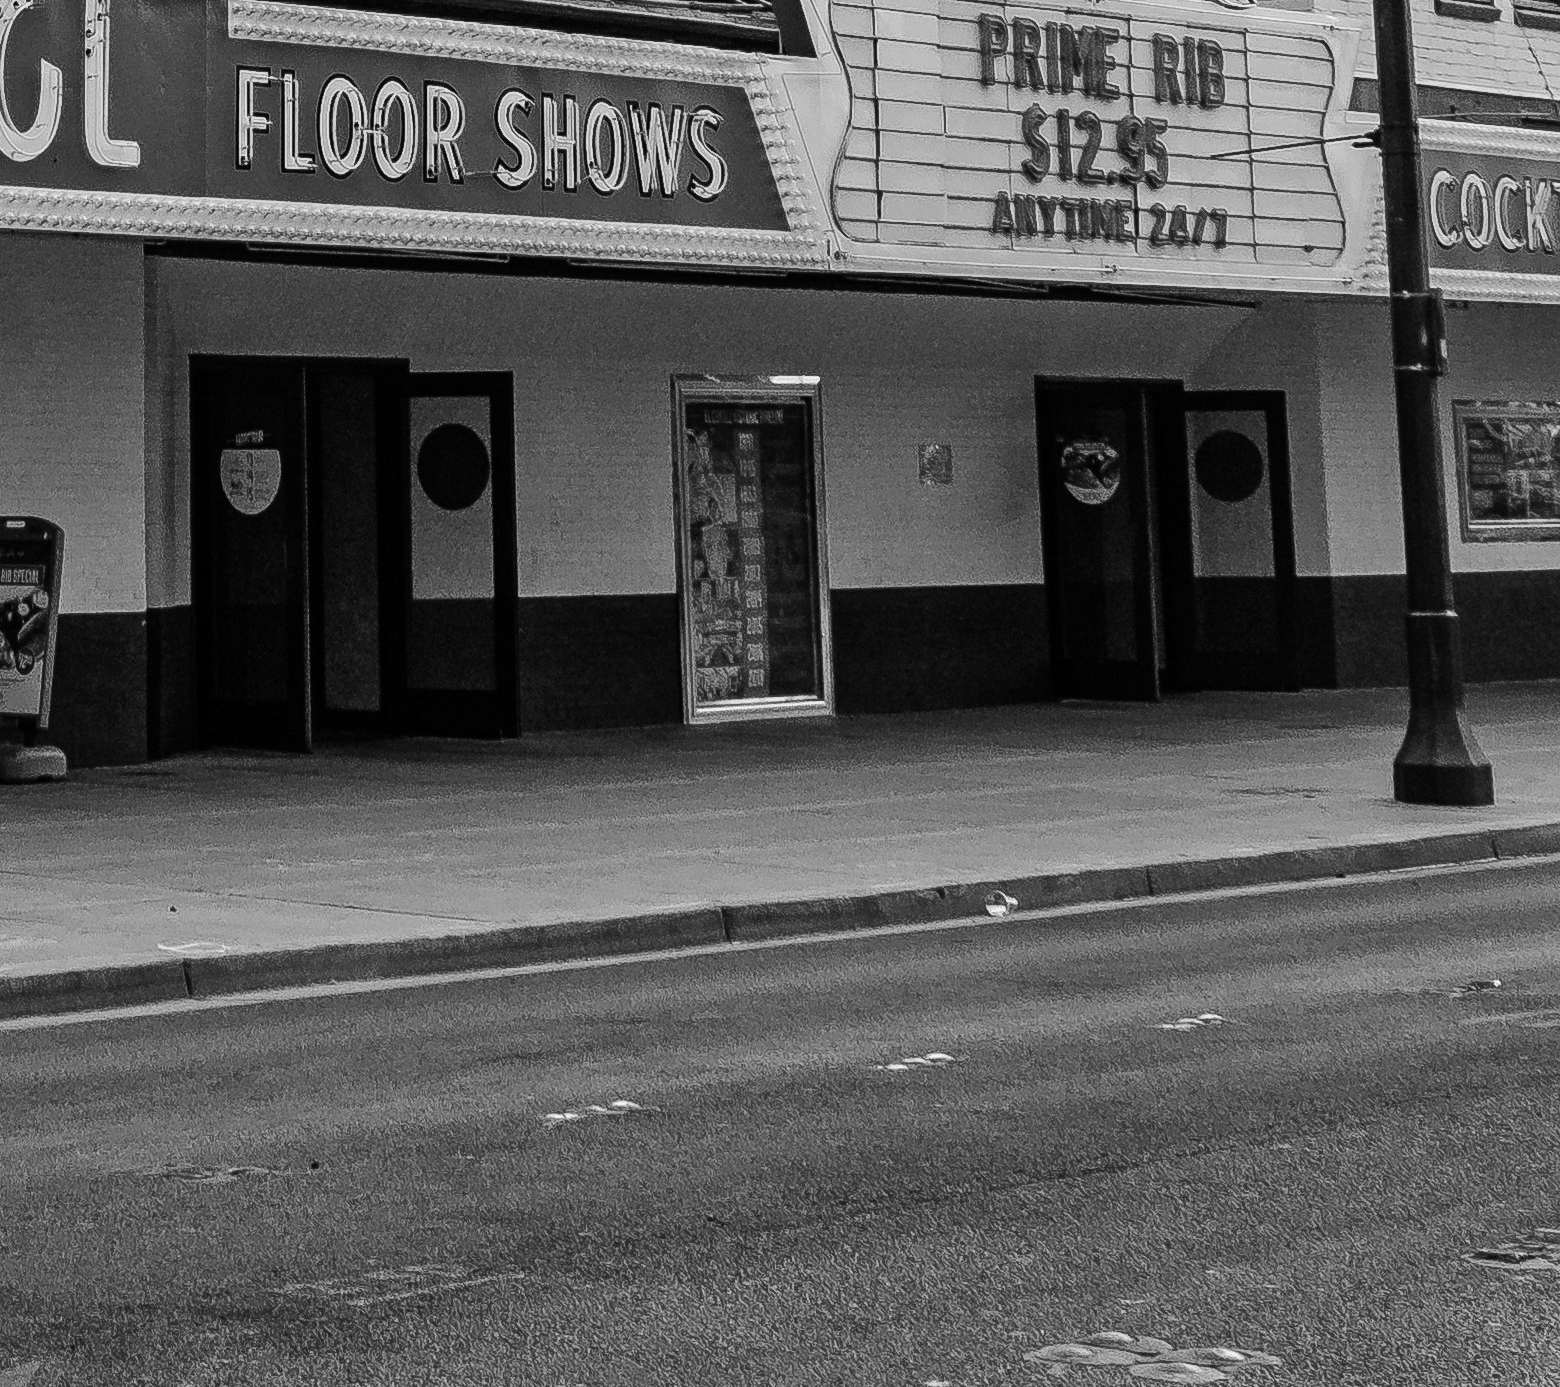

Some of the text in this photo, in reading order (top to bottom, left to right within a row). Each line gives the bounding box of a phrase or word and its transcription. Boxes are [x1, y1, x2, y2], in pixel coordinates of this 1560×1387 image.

[979, 13, 1225, 108] PRIME RIB
[234, 66, 728, 203] FLOOR SHOWS
[1021, 103, 1169, 189] $12.95
[992, 190, 1227, 249] ANYTIME 24/7
